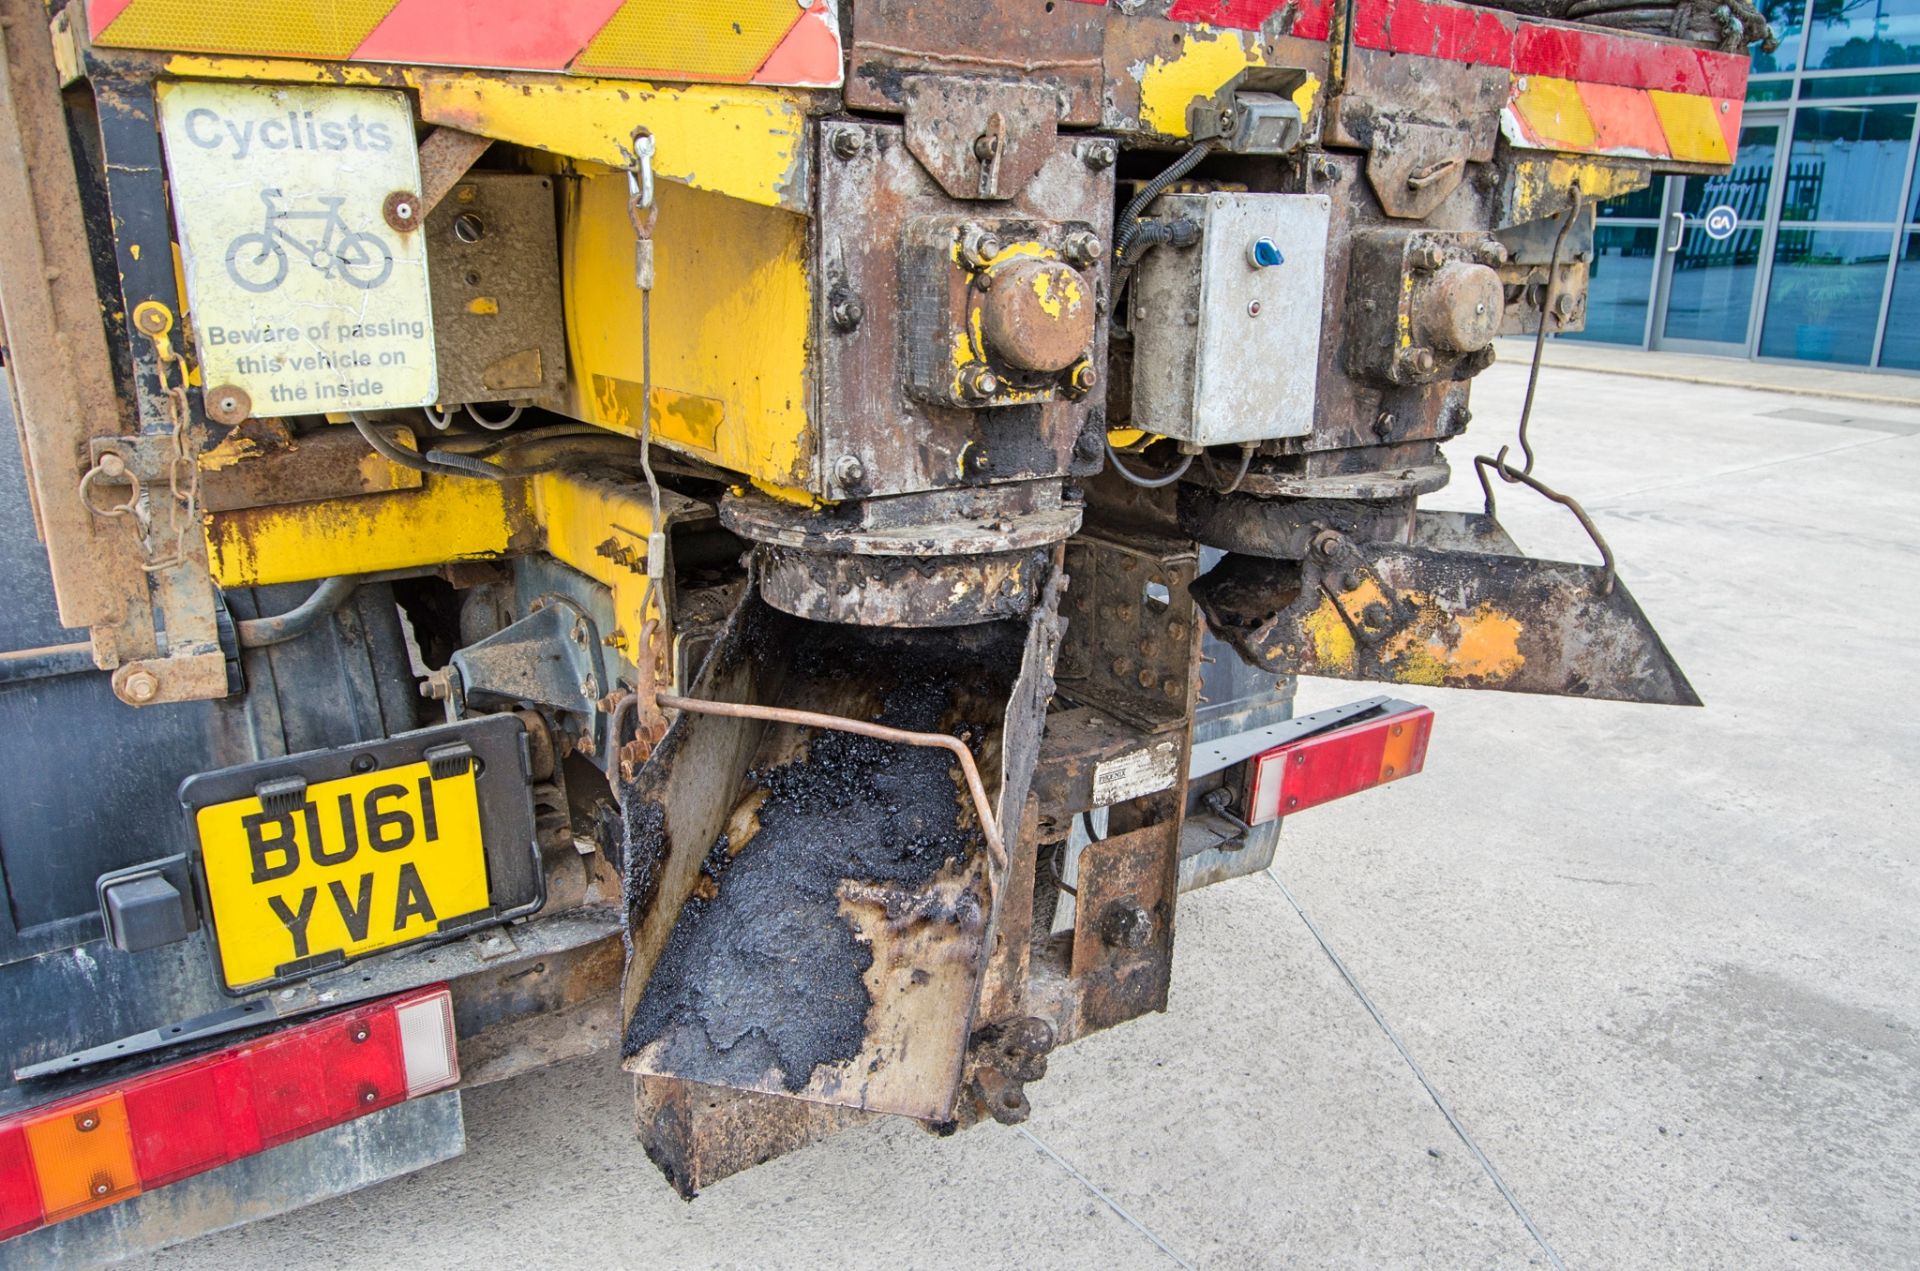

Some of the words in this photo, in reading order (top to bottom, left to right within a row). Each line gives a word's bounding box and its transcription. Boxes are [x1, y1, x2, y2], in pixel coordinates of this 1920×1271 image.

[184, 107, 393, 160] Cyclists
[208, 325, 300, 346] Beware
[307, 321, 330, 340] of
[337, 318, 425, 343] passing
[236, 354, 282, 375] this
[289, 350, 372, 372] vehicle
[378, 351, 407, 367] on
[270, 383, 308, 402] the
[315, 378, 384, 400] inside
[241, 776, 439, 885] BU61
[267, 862, 438, 959] YVA
